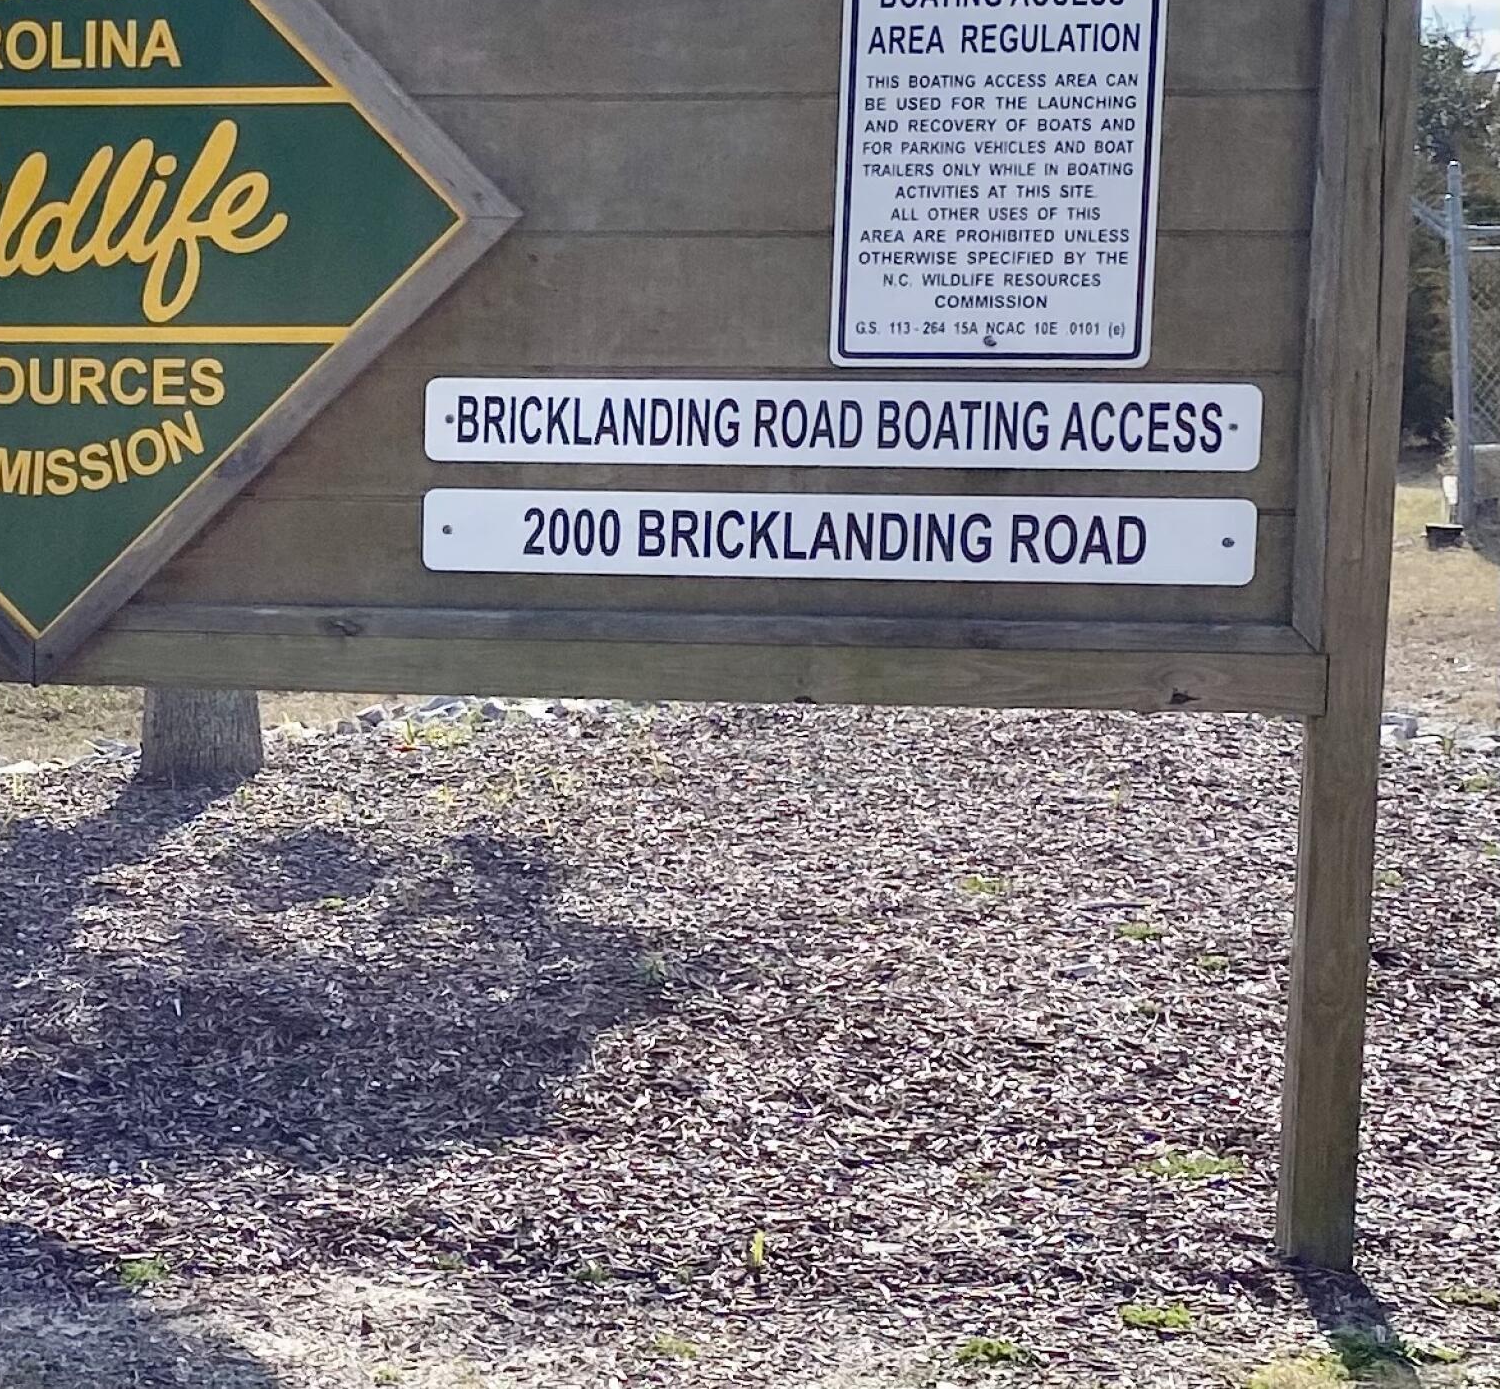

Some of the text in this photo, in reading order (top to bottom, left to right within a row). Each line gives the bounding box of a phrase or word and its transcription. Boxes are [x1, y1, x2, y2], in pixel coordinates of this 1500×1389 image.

[868, 23, 1139, 54] AREA REGULATION
[867, 74, 1138, 88] THIS BOATING ACCESS AREA CAN
[865, 96, 1136, 111] BE USED FOR THE LAUNCHING
[865, 118, 1135, 133] AND RECOVERY OF BOATS AND
[863, 140, 1134, 154] FOR PARKING VEHICLES AND BOAT
[863, 163, 1133, 177] TRAILERS ONLY WHILE IN BOATING
[895, 185, 978, 198] ACTIVITIES
[988, 185, 1007, 198] AT
[1017, 185, 1050, 198] THIS
[891, 207, 1100, 221] ALL OTHER USES OF THIS
[860, 229, 1129, 243] AREA ARE PROHIBITED UNLESS
[859, 251, 1128, 265] OTHERWISE SPECIFIED BY THE
[922, 274, 994, 287] WILDLIFE
[1004, 274, 1100, 287] RESOURCES
[935, 295, 1047, 308] COMMISSION
[954, 322, 977, 334] 15A
[986, 322, 1025, 334] NCAC
[1035, 322, 1058, 334] 10E
[458, 395, 1223, 452] BRICKLANDING ROAD BOATING ACCESS
[524, 508, 1146, 565] 2000 BRICKLANDING ROAD
